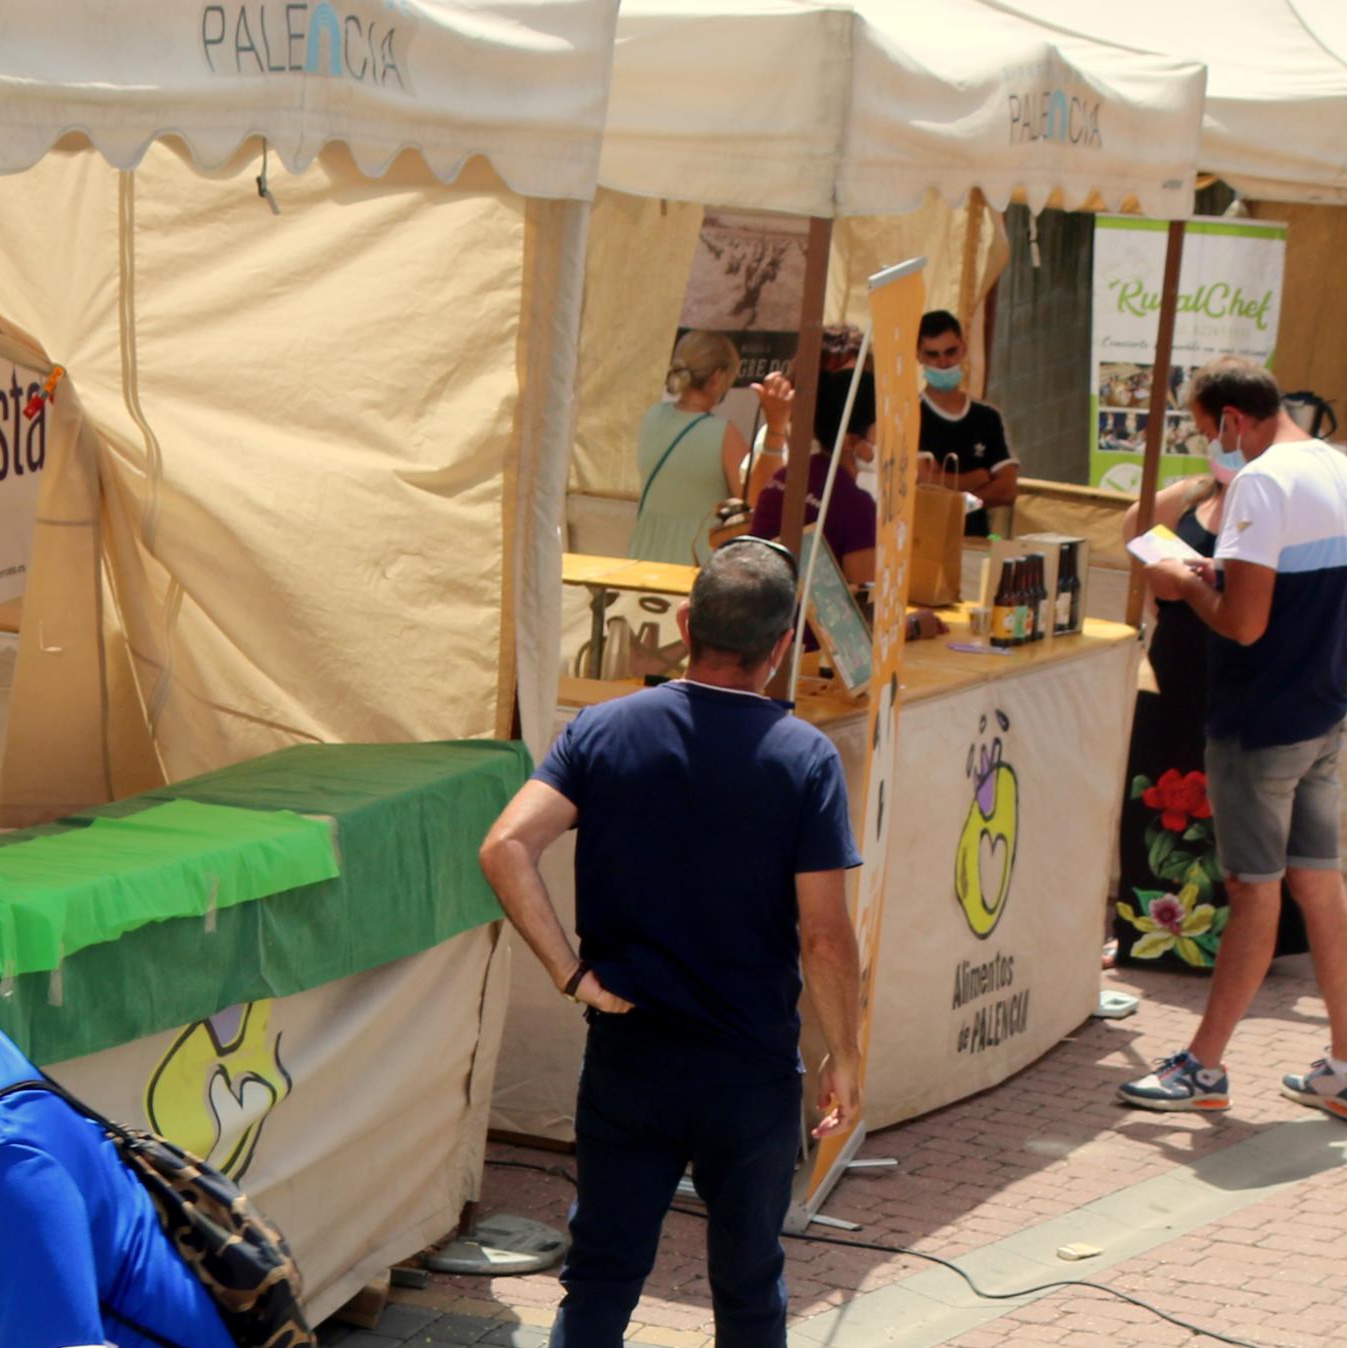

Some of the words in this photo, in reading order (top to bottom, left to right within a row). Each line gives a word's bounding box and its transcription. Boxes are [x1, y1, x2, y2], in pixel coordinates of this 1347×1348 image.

[1109, 277, 1273, 331] RualChef
[952, 951, 1014, 1010] Alimentos
[957, 1021, 969, 1052] de
[970, 989, 1030, 1056] PALENCIA
